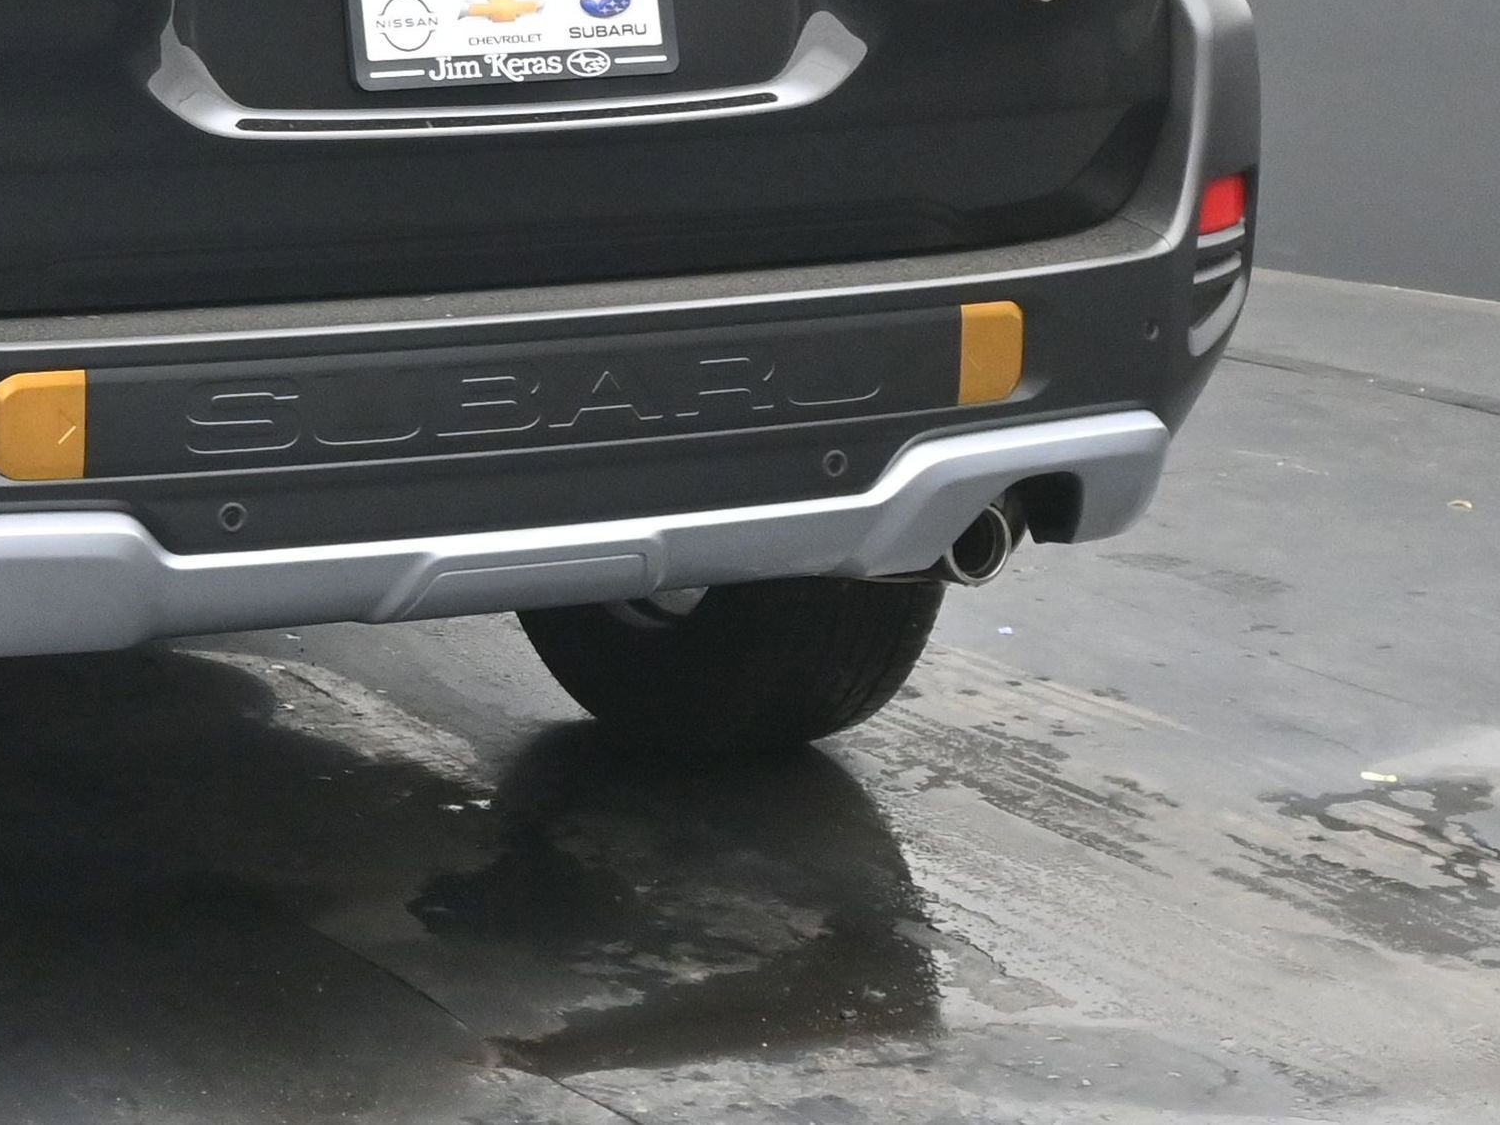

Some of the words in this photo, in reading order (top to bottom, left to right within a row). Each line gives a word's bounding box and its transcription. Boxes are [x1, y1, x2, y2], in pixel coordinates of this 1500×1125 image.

[376, 16, 439, 29] NISSAN
[569, 23, 648, 39] SUBARU
[468, 33, 544, 46] CHEVROLET
[428, 56, 483, 81] Jim
[484, 53, 564, 83] Keras
[186, 349, 882, 454] SUBARU
